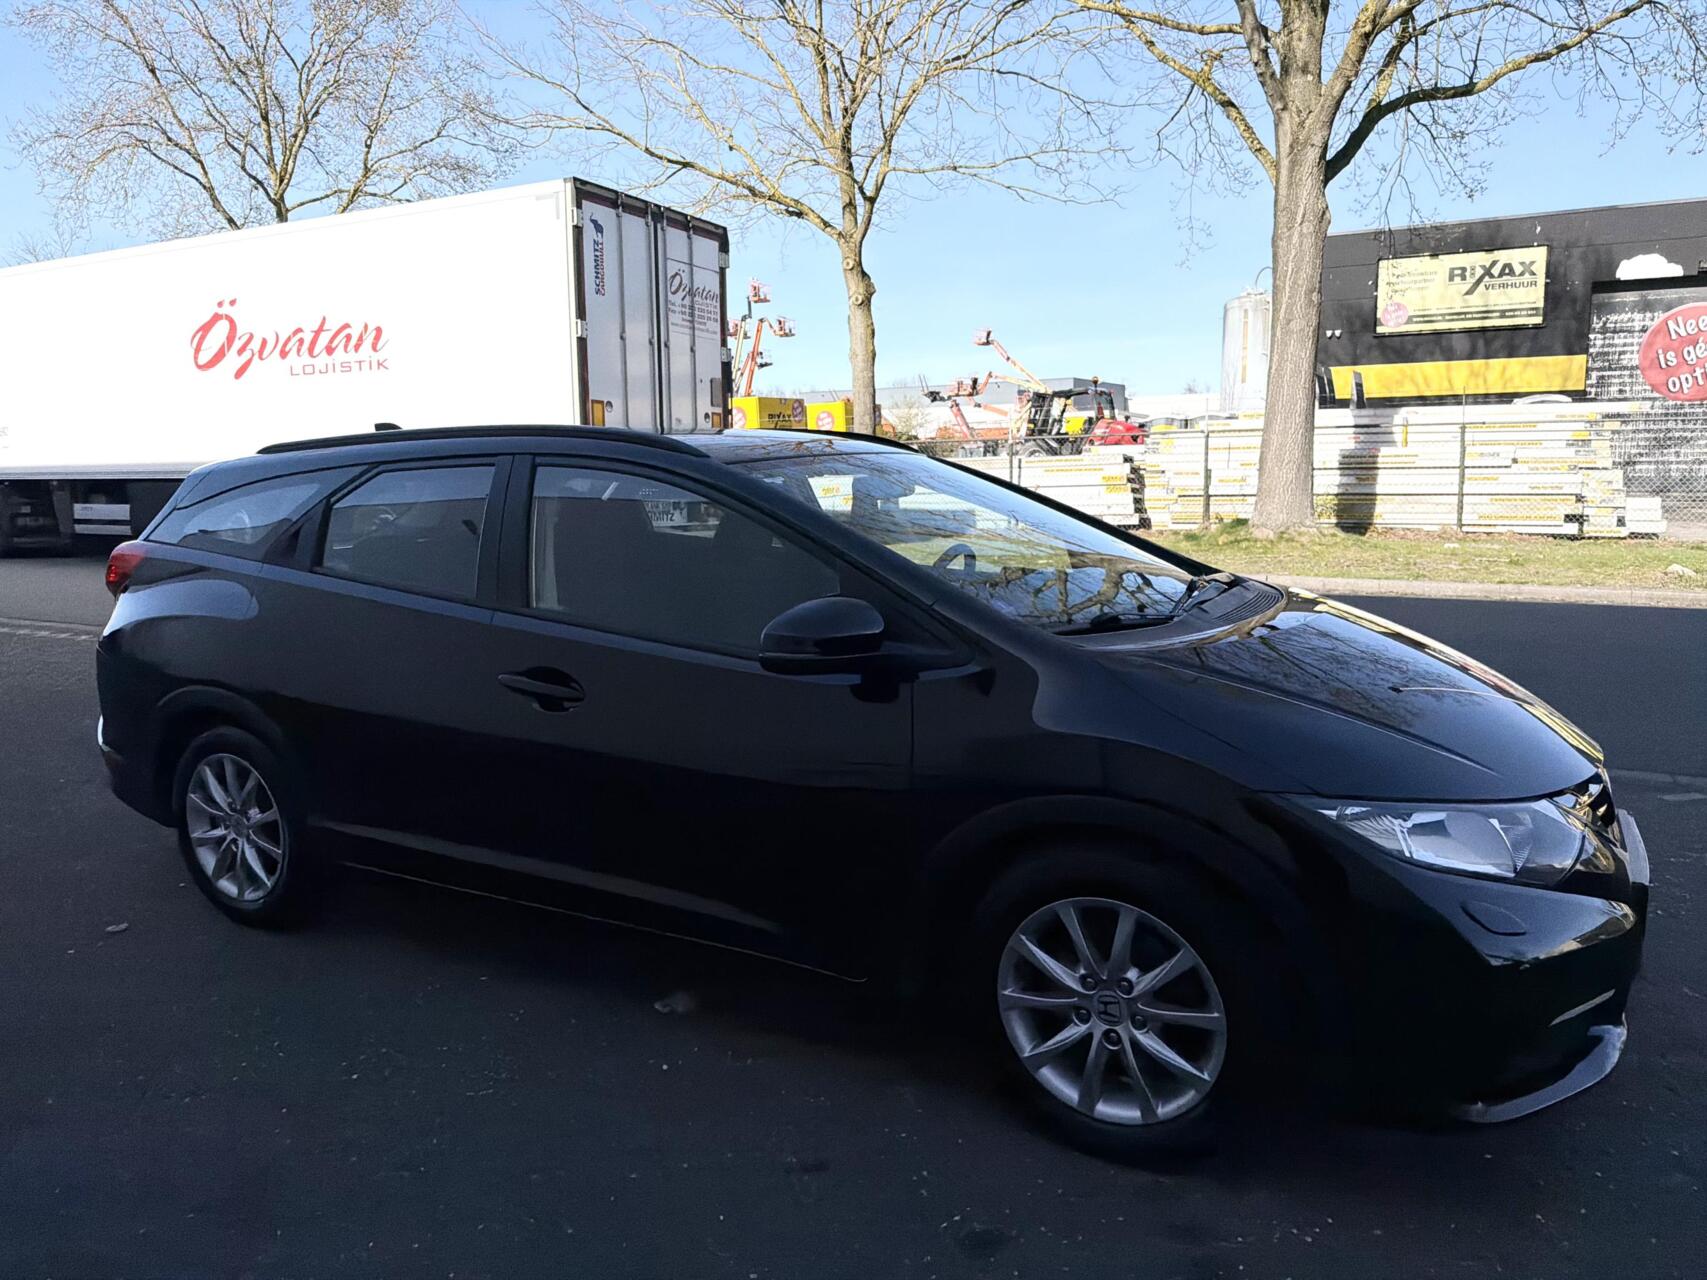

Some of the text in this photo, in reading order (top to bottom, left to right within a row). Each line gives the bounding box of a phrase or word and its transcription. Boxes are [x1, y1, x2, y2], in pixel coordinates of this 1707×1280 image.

[593, 239, 601, 295] SCHMITZ
[1448, 260, 1537, 296] RIXAX
[669, 268, 719, 303] Özvatan
[1484, 280, 1538, 291] VERHUUR
[190, 298, 390, 380] Özvatan
[1657, 336, 1707, 368] is gé
[290, 356, 389, 376] LOJİSTİK
